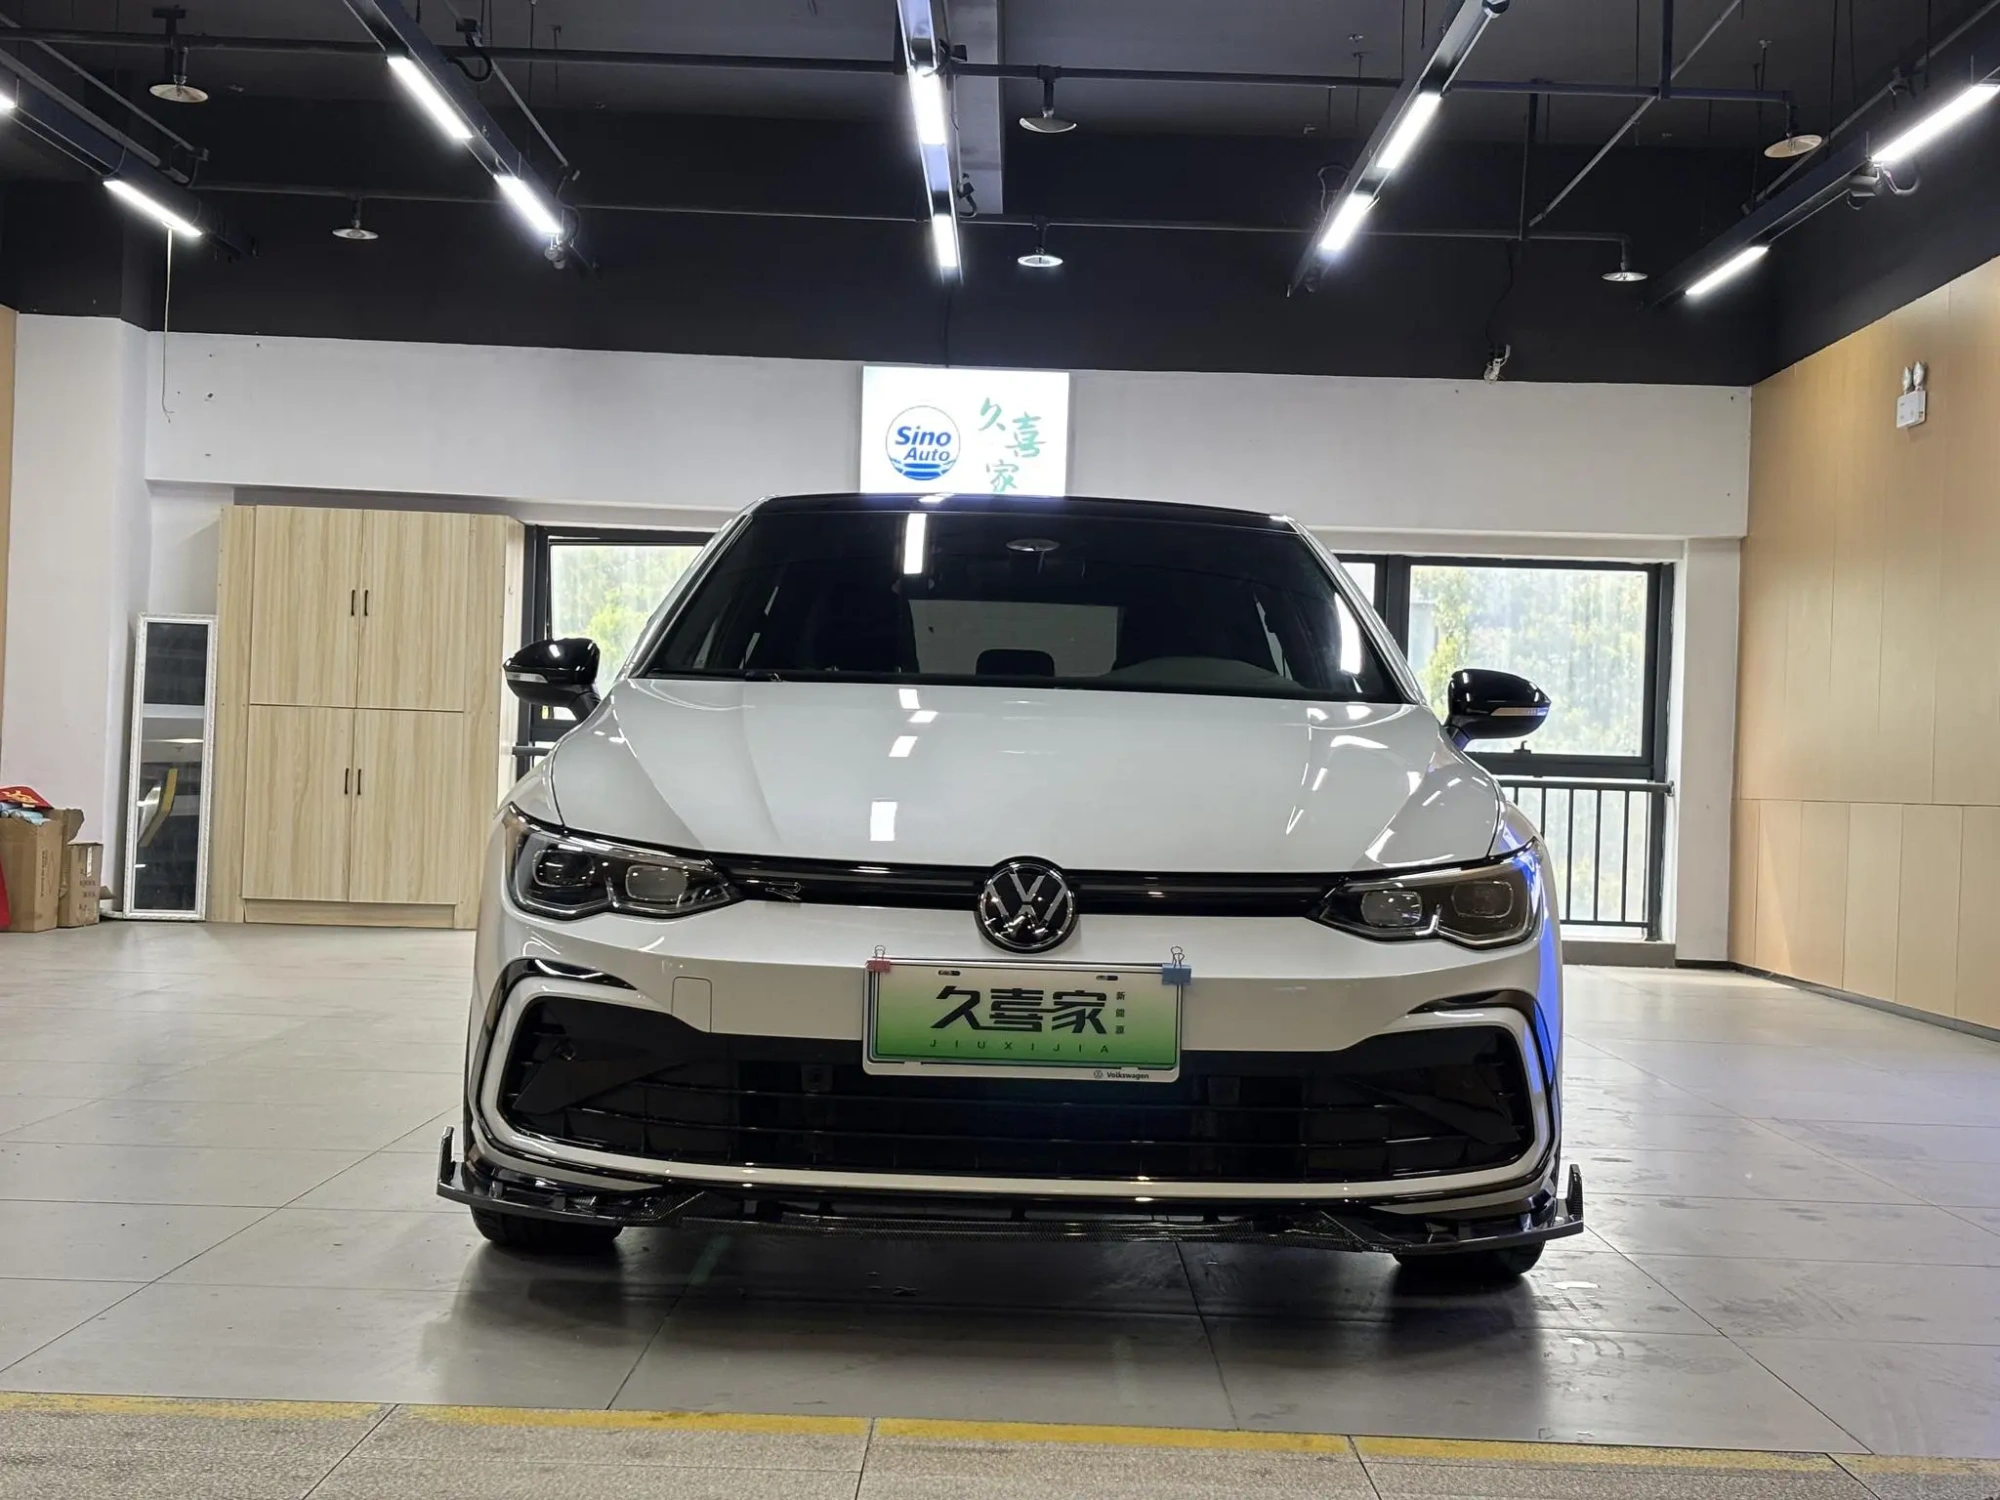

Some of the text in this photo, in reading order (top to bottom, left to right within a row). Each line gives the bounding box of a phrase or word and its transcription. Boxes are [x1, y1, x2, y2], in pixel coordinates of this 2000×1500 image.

[895, 425, 951, 446] Sino
[904, 447, 950, 461] Auto
[931, 985, 1107, 1035] 久喜家
[1106, 1072, 1149, 1080] Volkswagen
